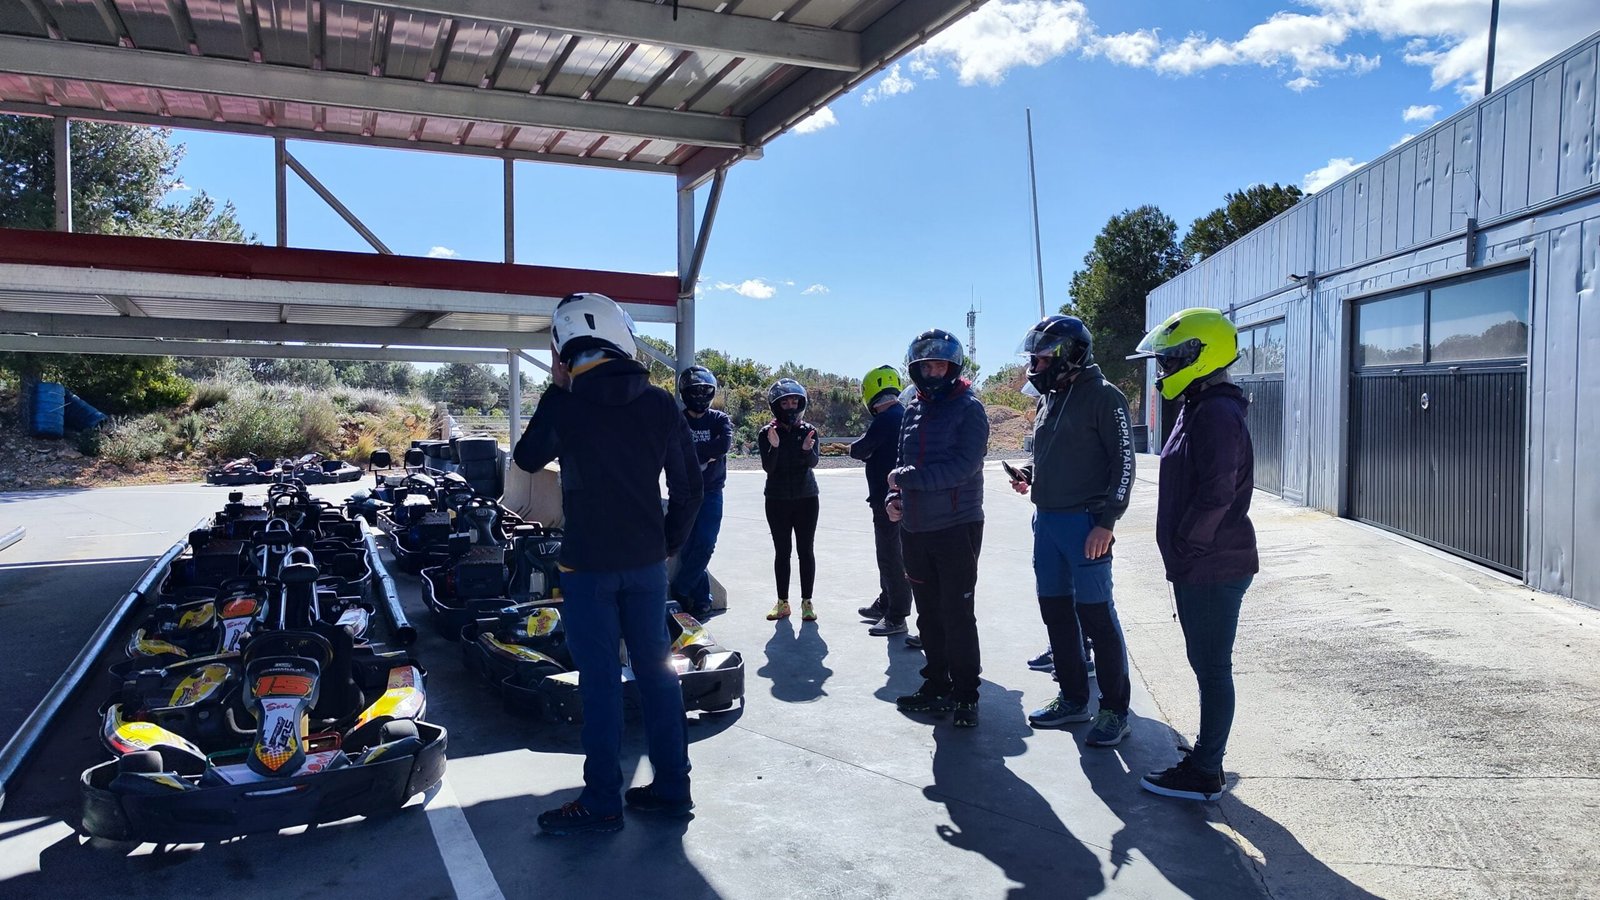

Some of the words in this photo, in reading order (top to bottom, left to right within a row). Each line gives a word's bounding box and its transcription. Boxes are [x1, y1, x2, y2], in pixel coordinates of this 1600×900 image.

[1117, 407, 1129, 446] UTOPIA
[1116, 449, 1131, 501] PARADISE
[538, 541, 562, 555] 17
[252, 674, 312, 698] 15
